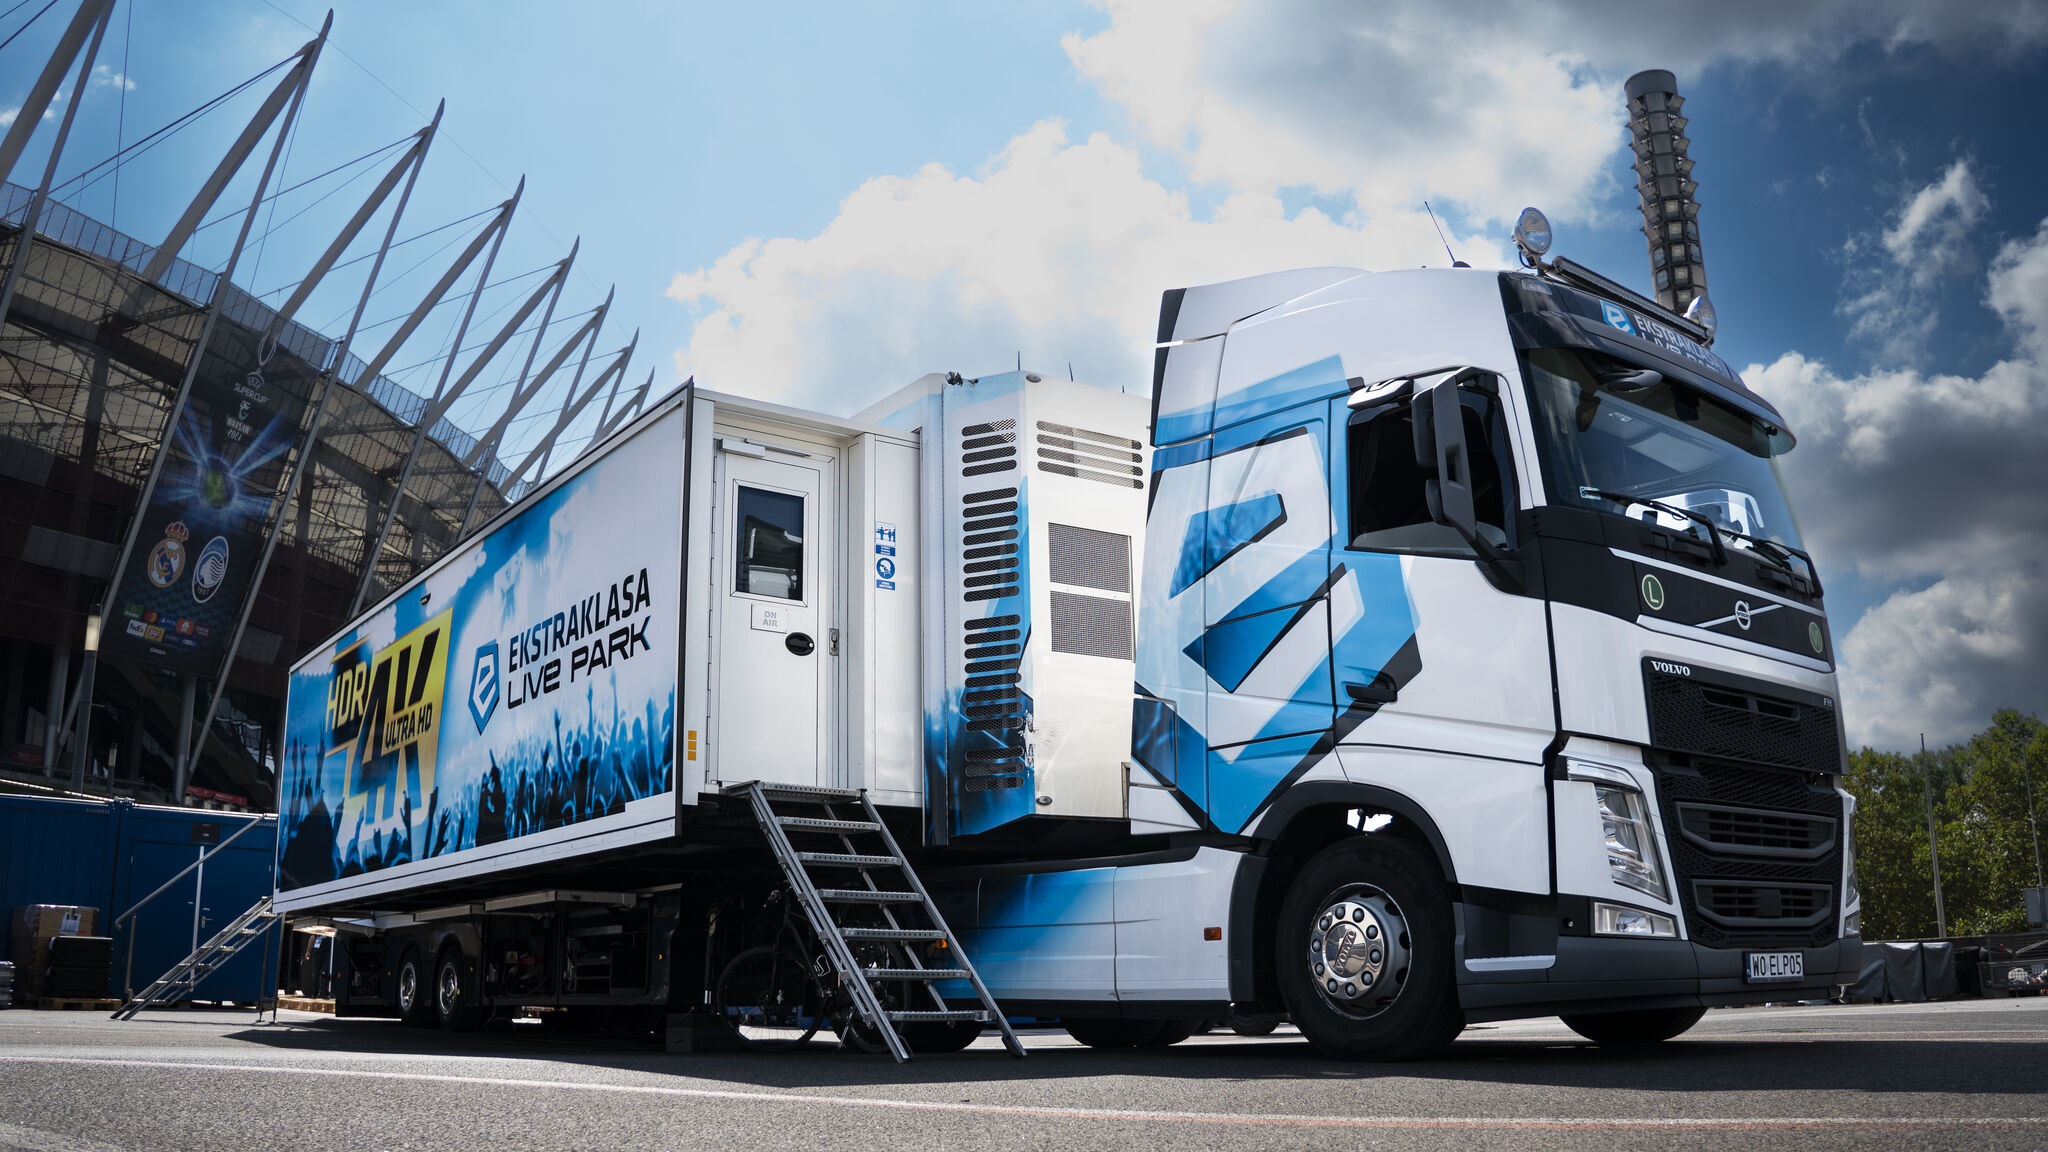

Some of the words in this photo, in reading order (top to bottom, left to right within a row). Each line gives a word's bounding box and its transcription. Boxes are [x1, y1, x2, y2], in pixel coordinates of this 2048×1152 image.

[233, 382, 255, 399] SUPER
[509, 567, 651, 673] EKSTRAKLASA
[763, 619, 778, 627] AIR
[765, 610, 777, 619] ON
[570, 615, 651, 683] PARK
[1650, 660, 1691, 676] VOLVO
[325, 660, 368, 734] HDR
[385, 710, 416, 750] ULTRA
[417, 702, 433, 735] HD
[1336, 929, 1356, 970] VOLVO
